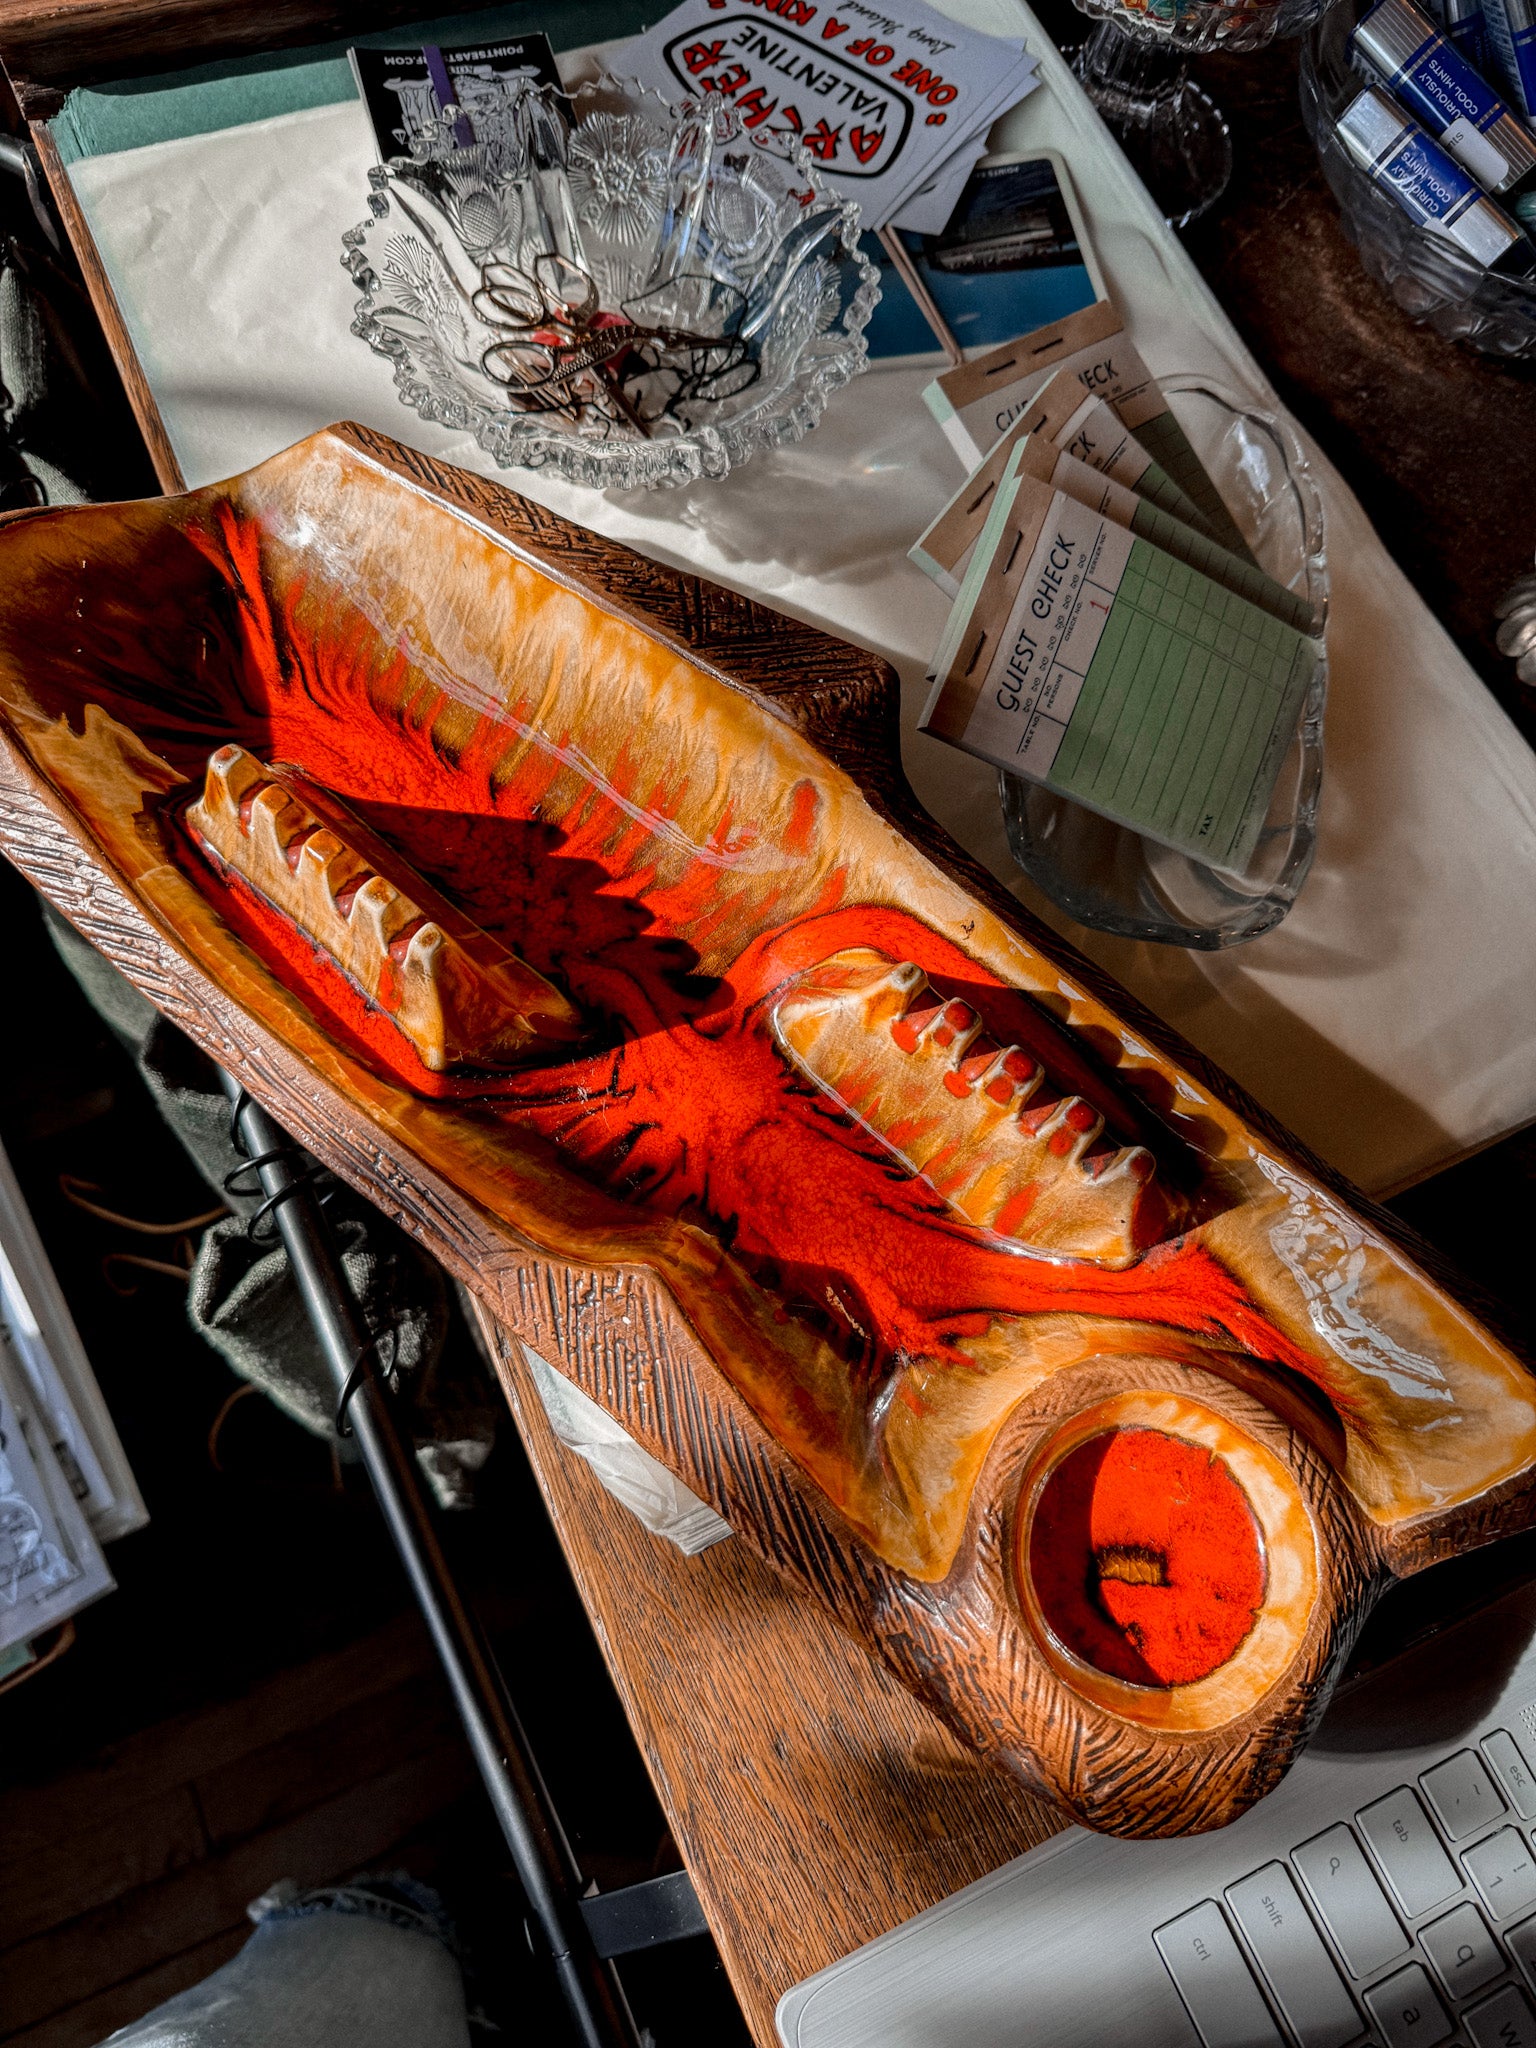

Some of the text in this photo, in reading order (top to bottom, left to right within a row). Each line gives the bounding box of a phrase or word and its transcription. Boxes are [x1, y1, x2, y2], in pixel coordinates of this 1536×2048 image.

[821, 17, 849, 40] A
[837, 0, 956, 55] Long Island
[845, 38, 895, 66] OF
[731, 25, 889, 123] VALENTINE
[1428, 59, 1479, 115] COOL MINTS
[1401, 152, 1451, 204] COOL MINTS
[1089, 546, 1102, 575] SERVER
[1090, 600, 1109, 614] 1
[996, 532, 1076, 712] GUEST CHECK
[1064, 616, 1078, 642] CHECK
[1047, 673, 1064, 709] PERSONS
[1021, 730, 1035, 754] TABLE
[1199, 814, 1214, 837] TAX
[1509, 1764, 1526, 1788] esc
[1392, 1819, 1409, 1843] tab
[1489, 1876, 1504, 1889] 1
[1261, 1895, 1284, 1928] shift
[1192, 1937, 1212, 1961] ctrl
[1455, 1944, 1476, 1968] q
[1402, 2006, 1421, 2026] a
[1499, 2021, 1522, 2048] w
